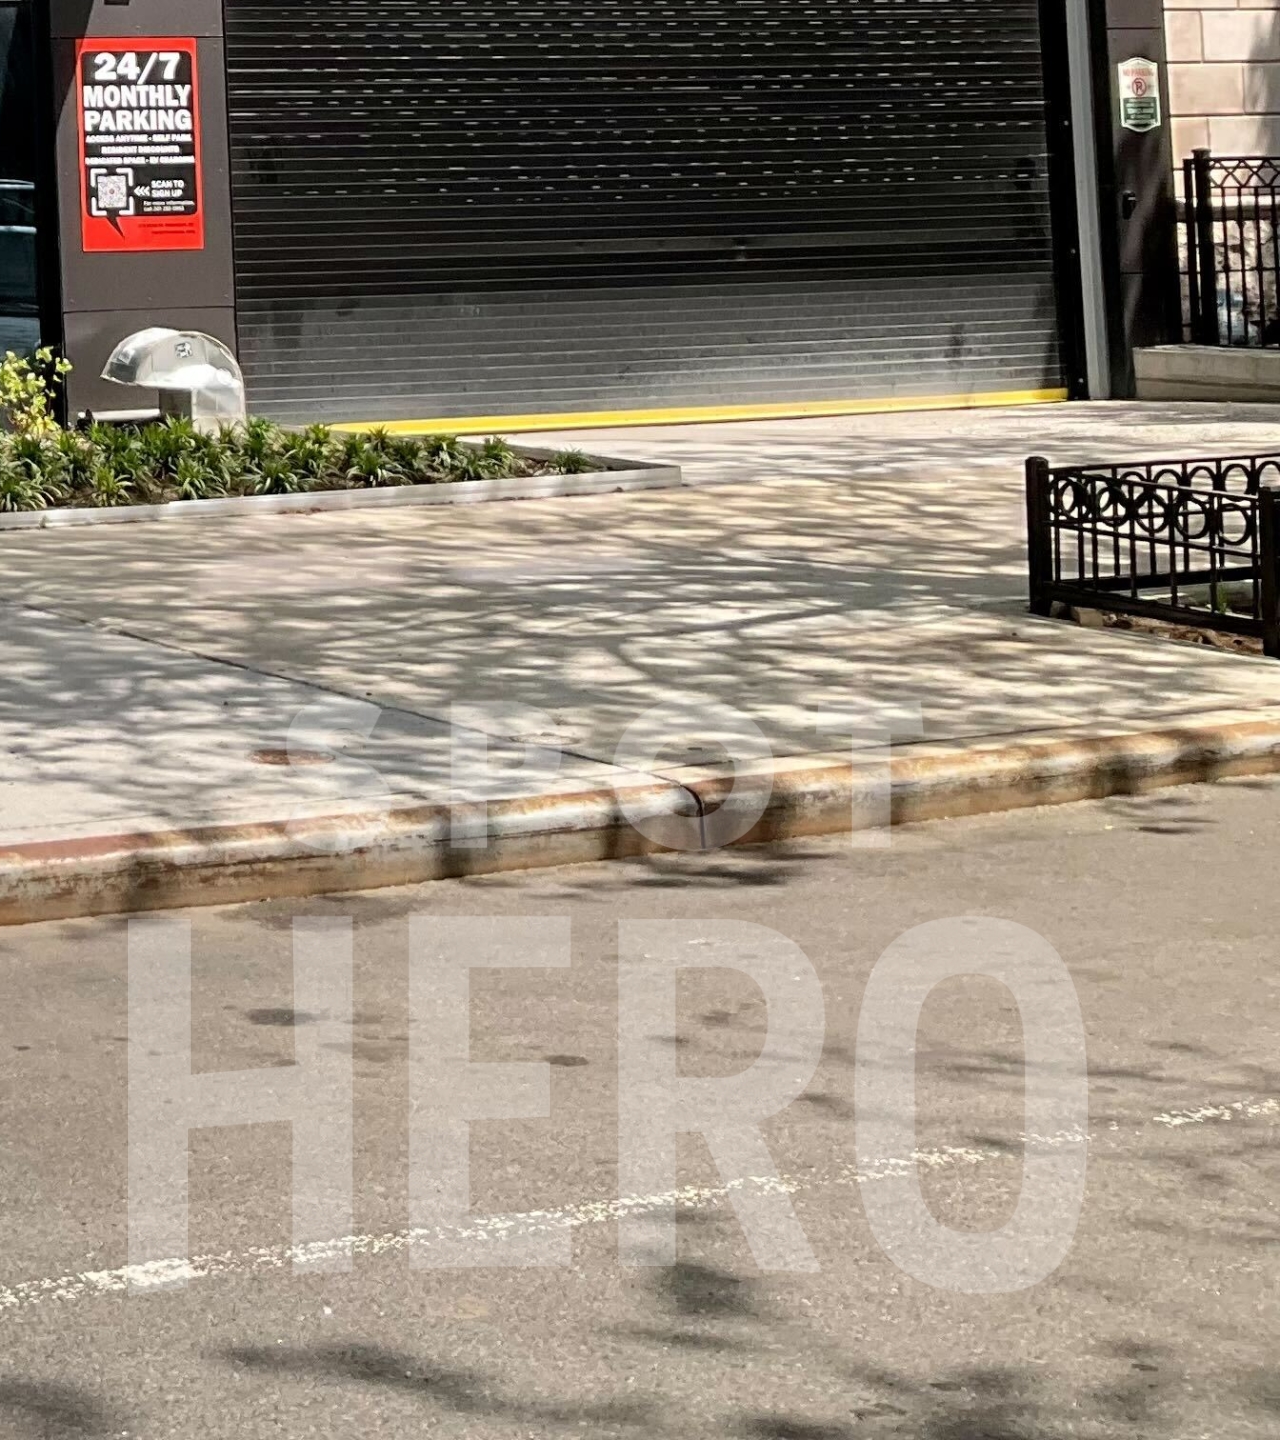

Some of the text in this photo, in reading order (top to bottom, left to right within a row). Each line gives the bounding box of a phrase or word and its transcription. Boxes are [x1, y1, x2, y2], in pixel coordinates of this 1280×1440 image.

[94, 52, 180, 85] 24/7
[83, 84, 192, 108] MONTHLY
[84, 109, 193, 131] PARKING
[151, 179, 185, 189] SCAN TO
[151, 189, 183, 198] SIGN UP
